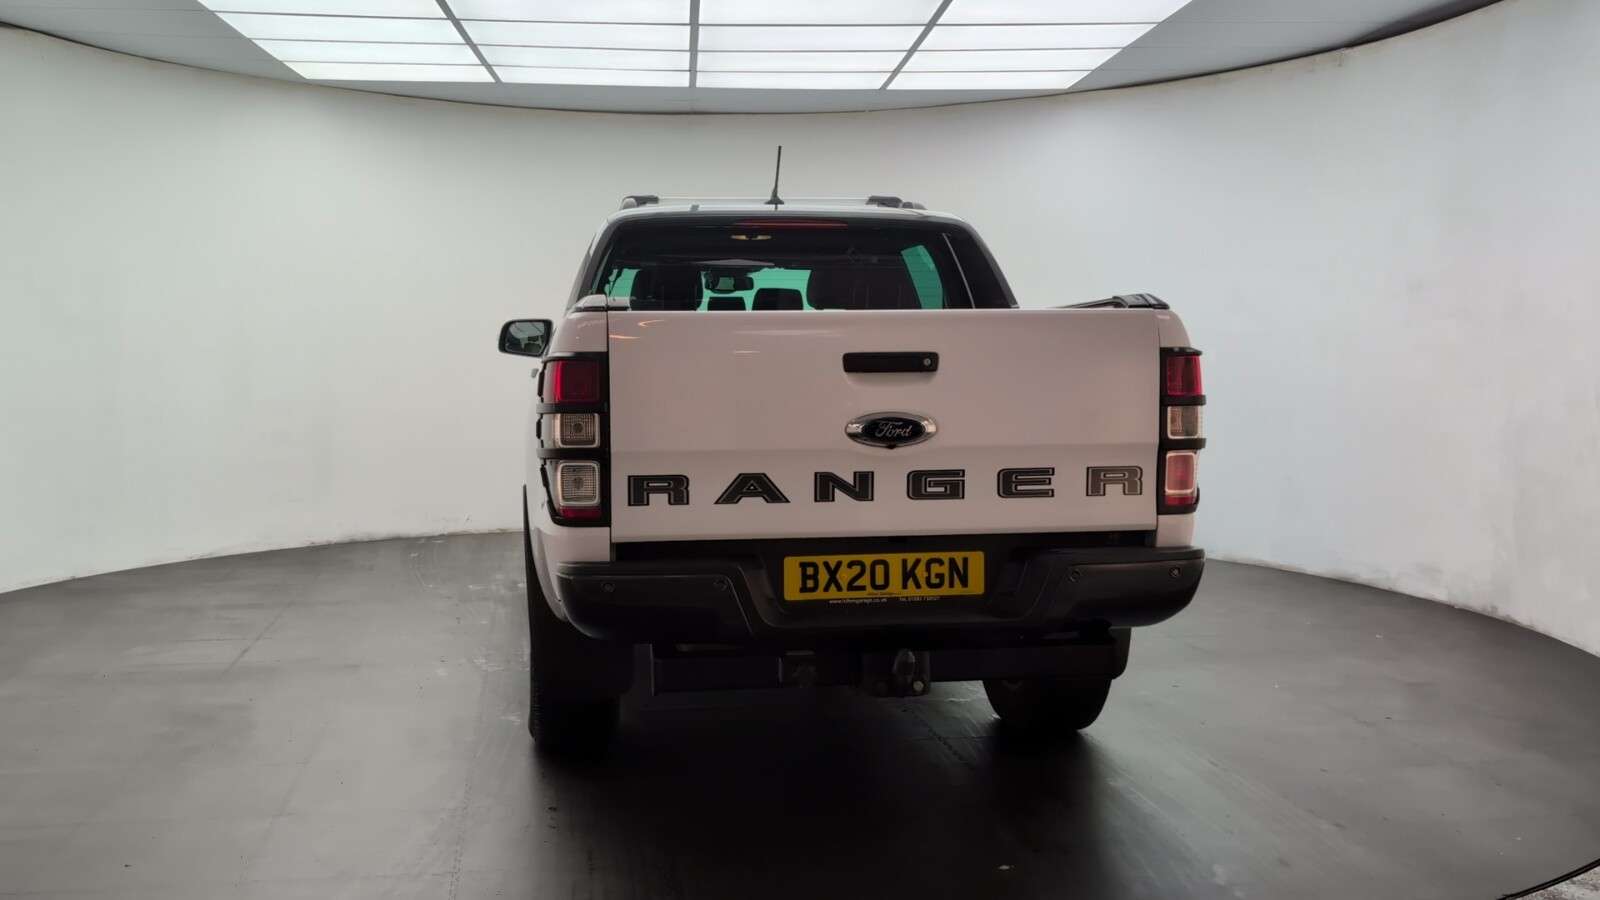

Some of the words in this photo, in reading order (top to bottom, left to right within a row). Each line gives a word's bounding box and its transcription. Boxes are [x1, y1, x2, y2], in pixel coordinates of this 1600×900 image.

[874, 422, 912, 438] Ford
[628, 465, 1143, 506] RANGER
[799, 559, 890, 593] BX20
[901, 557, 969, 590] KGN
